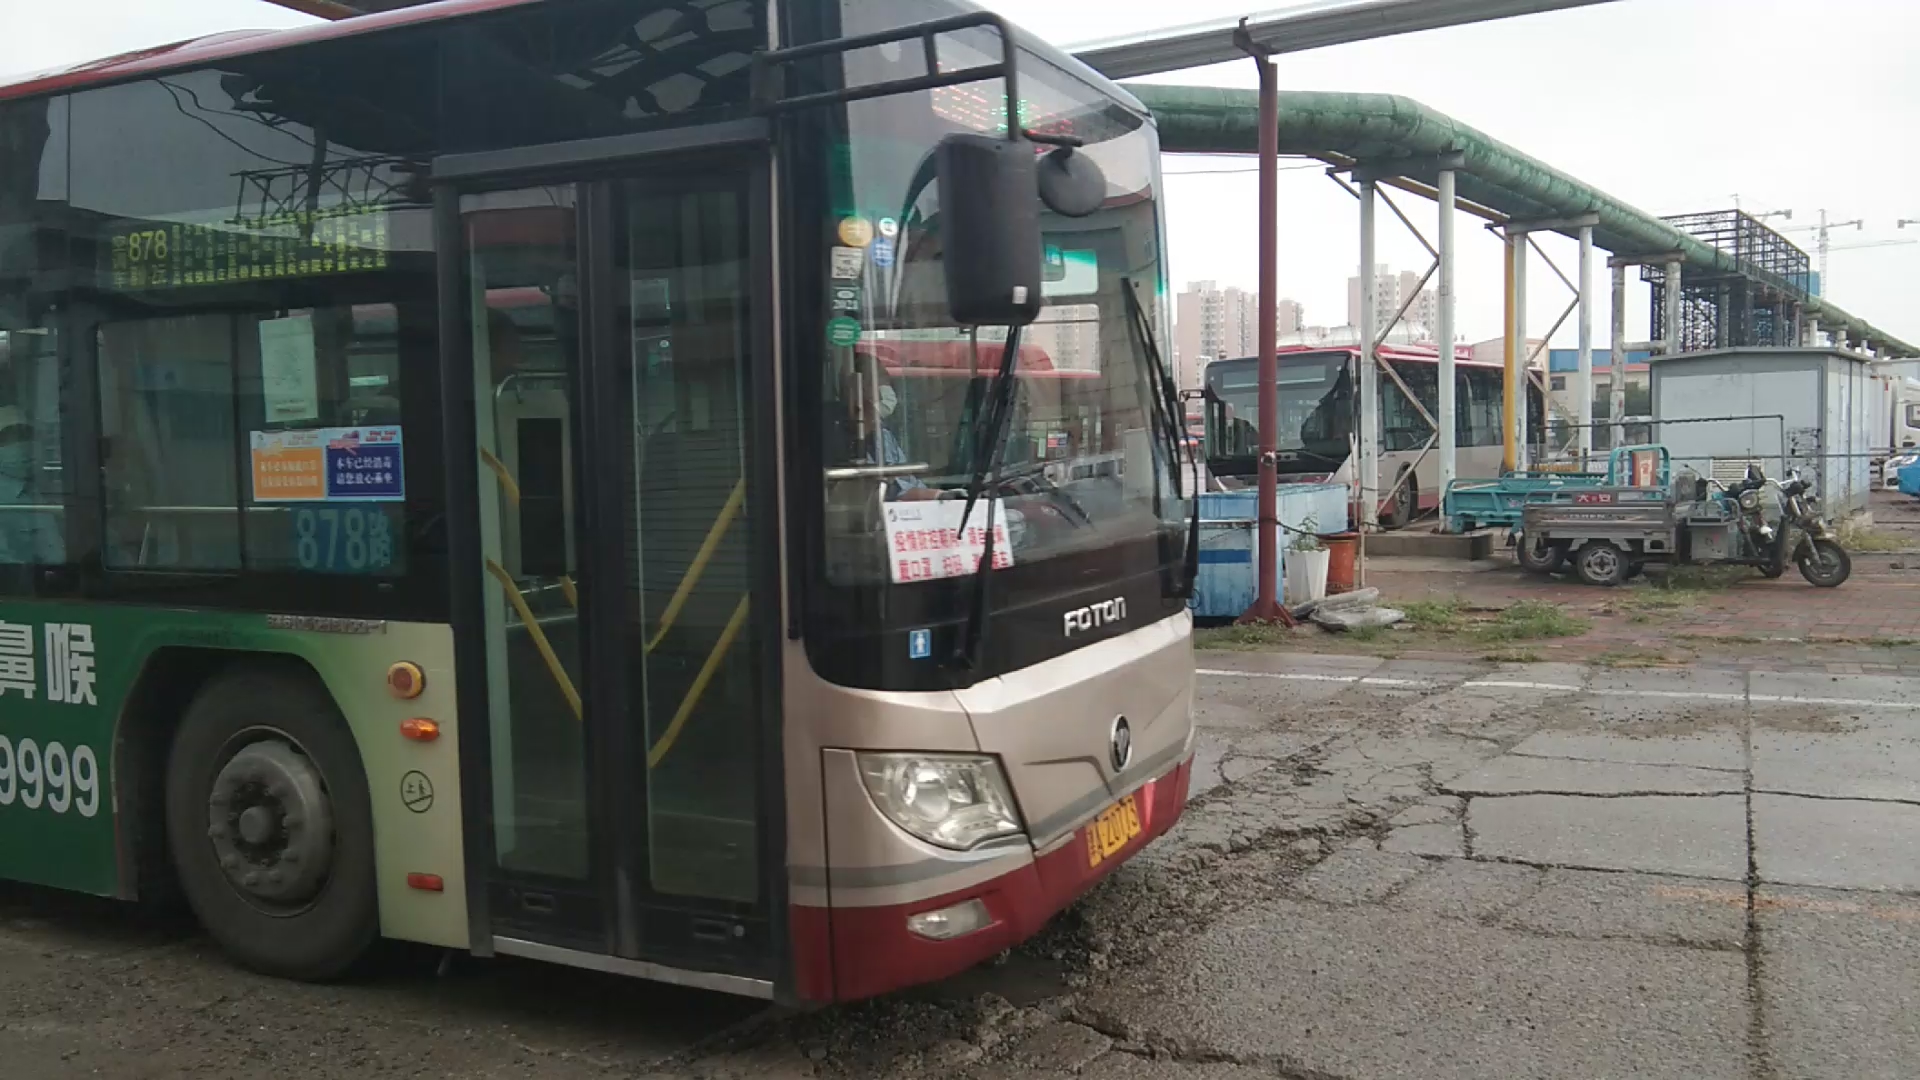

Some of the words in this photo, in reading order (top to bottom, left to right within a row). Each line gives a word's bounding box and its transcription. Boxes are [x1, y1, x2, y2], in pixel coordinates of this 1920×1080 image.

[128, 229, 167, 263] 878
[1064, 595, 1126, 637] FOTON
[0, 619, 98, 706] 鼻喉
[0, 733, 99, 818] 9999
